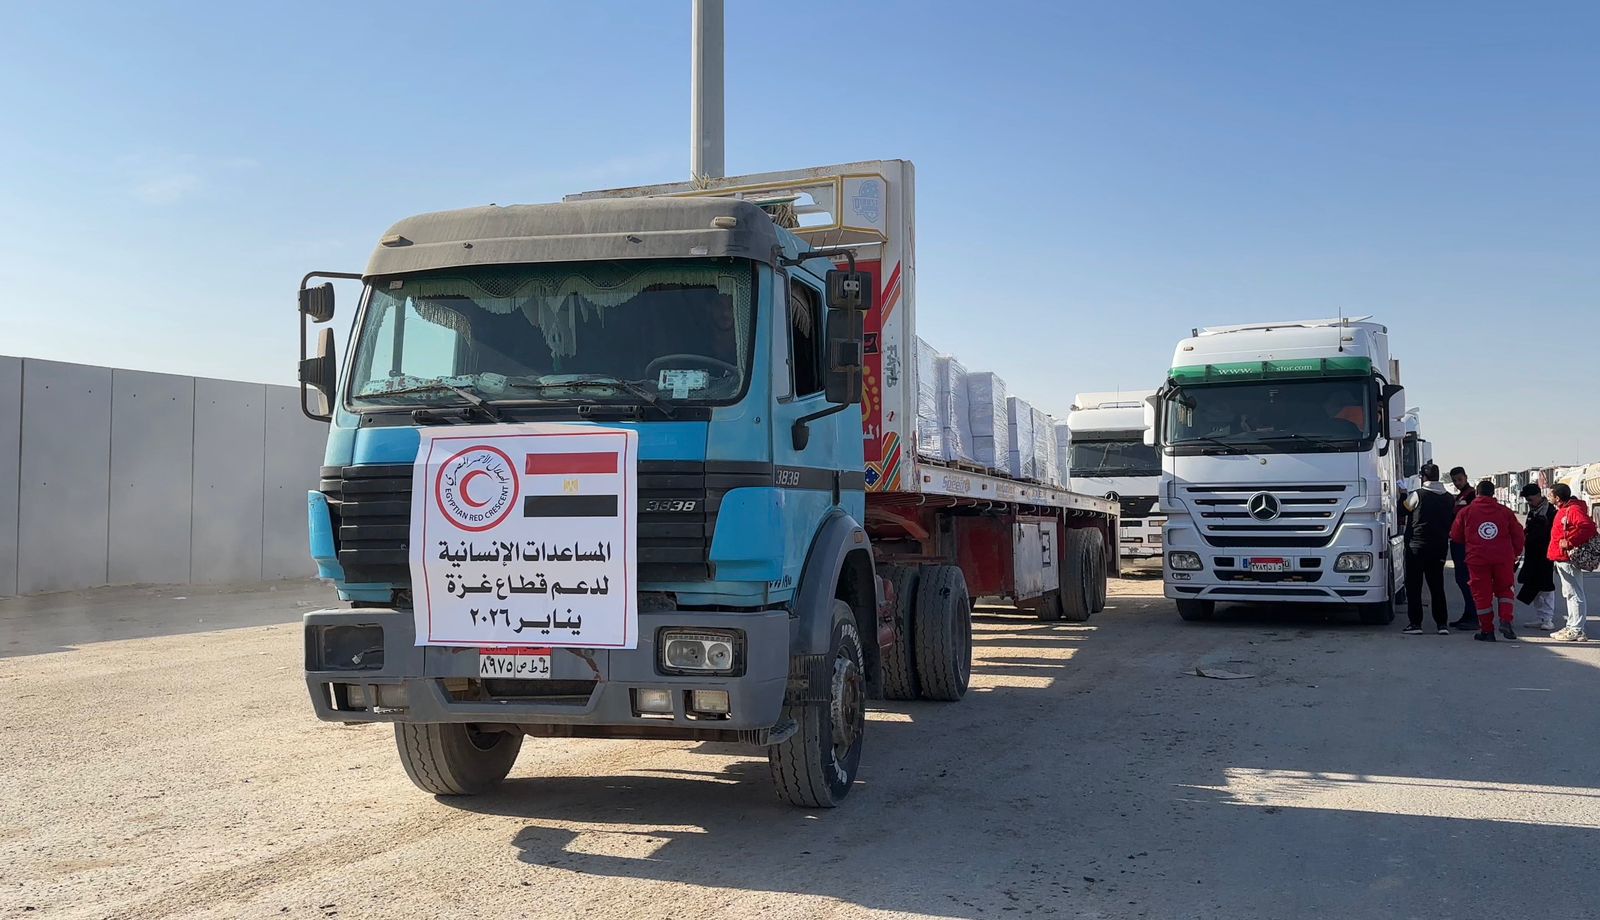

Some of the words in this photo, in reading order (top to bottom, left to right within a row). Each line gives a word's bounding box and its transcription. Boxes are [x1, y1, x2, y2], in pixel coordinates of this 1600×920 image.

[776, 470, 800, 486] 3838
[445, 488, 469, 520] EGYPTIAN
[469, 513, 484, 522] RED
[484, 486, 509, 519] CRESCENT
[646, 500, 696, 512] 3838
[438, 540, 520, 567] الإنسانية
[523, 541, 611, 563] المساعدات
[445, 573, 493, 599] غزة
[496, 573, 548, 600] قطاع
[551, 575, 609, 600] لدعم
[470, 608, 511, 627] ٢٠٢٦
[513, 608, 582, 636] يناير
[481, 657, 513, 674] ٨٩٧٥
